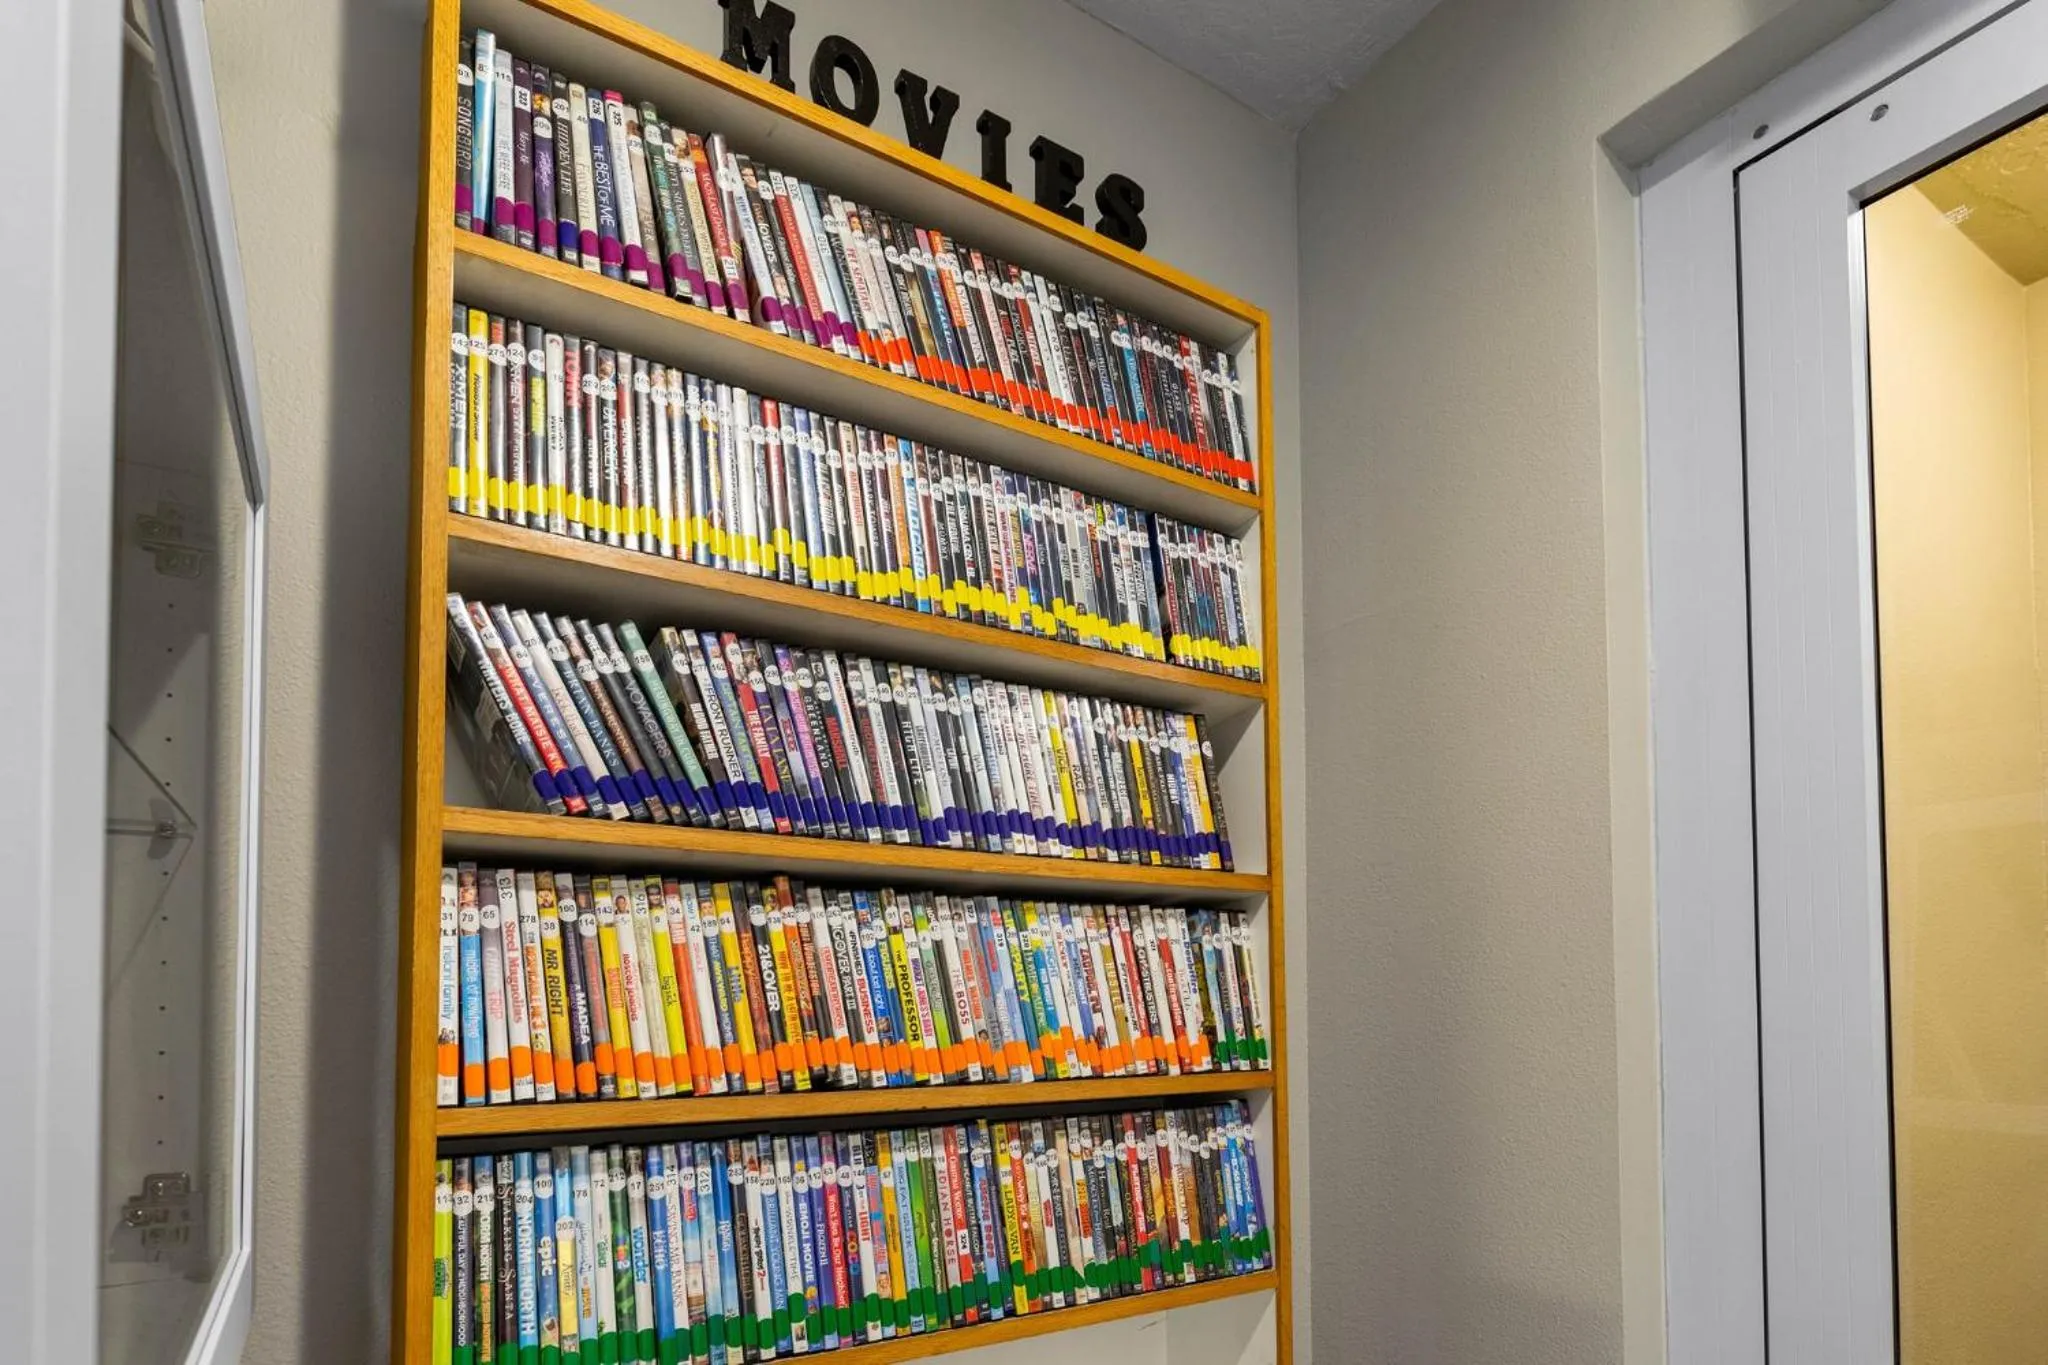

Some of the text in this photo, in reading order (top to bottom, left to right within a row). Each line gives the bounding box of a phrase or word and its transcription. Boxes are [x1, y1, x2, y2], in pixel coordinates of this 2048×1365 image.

[718, 0, 1147, 251] MOVIES
[560, 169, 572, 196] LIFE
[595, 162, 611, 190] BEST
[600, 205, 614, 227] ME
[757, 222, 777, 263] lovers
[505, 713, 529, 745] BONE
[526, 706, 550, 748] MAISIE
[624, 681, 672, 759] VOYAGERS
[703, 687, 740, 779] FRONT RUNNER
[746, 710, 771, 758] THE FAMILY
[804, 696, 829, 768] GREENLAND
[900, 721, 921, 785] HIGH LIFE
[1056, 748, 1067, 774] VICE
[1072, 765, 1085, 796] RACE
[504, 921, 525, 1024] Steel Magnolias
[546, 949, 564, 1018] MR RIGHT
[1013, 952, 1030, 1003] PARTY
[441, 983, 456, 1020] family
[576, 991, 591, 1045] MADEA
[856, 977, 875, 1034] BUSINESS
[898, 964, 920, 1042] PROFESSOR
[956, 991, 970, 1025] BOSS
[799, 1203, 815, 1283] EMOJI MOVIE
[859, 1211, 870, 1242] LIGHT
[1004, 1191, 1019, 1255] LADY VAN
[495, 1185, 516, 1320] STALKING SANTA
[538, 1236, 556, 1276] epic
[633, 1226, 648, 1285] wonder
[520, 1276, 535, 1335] NORTH
